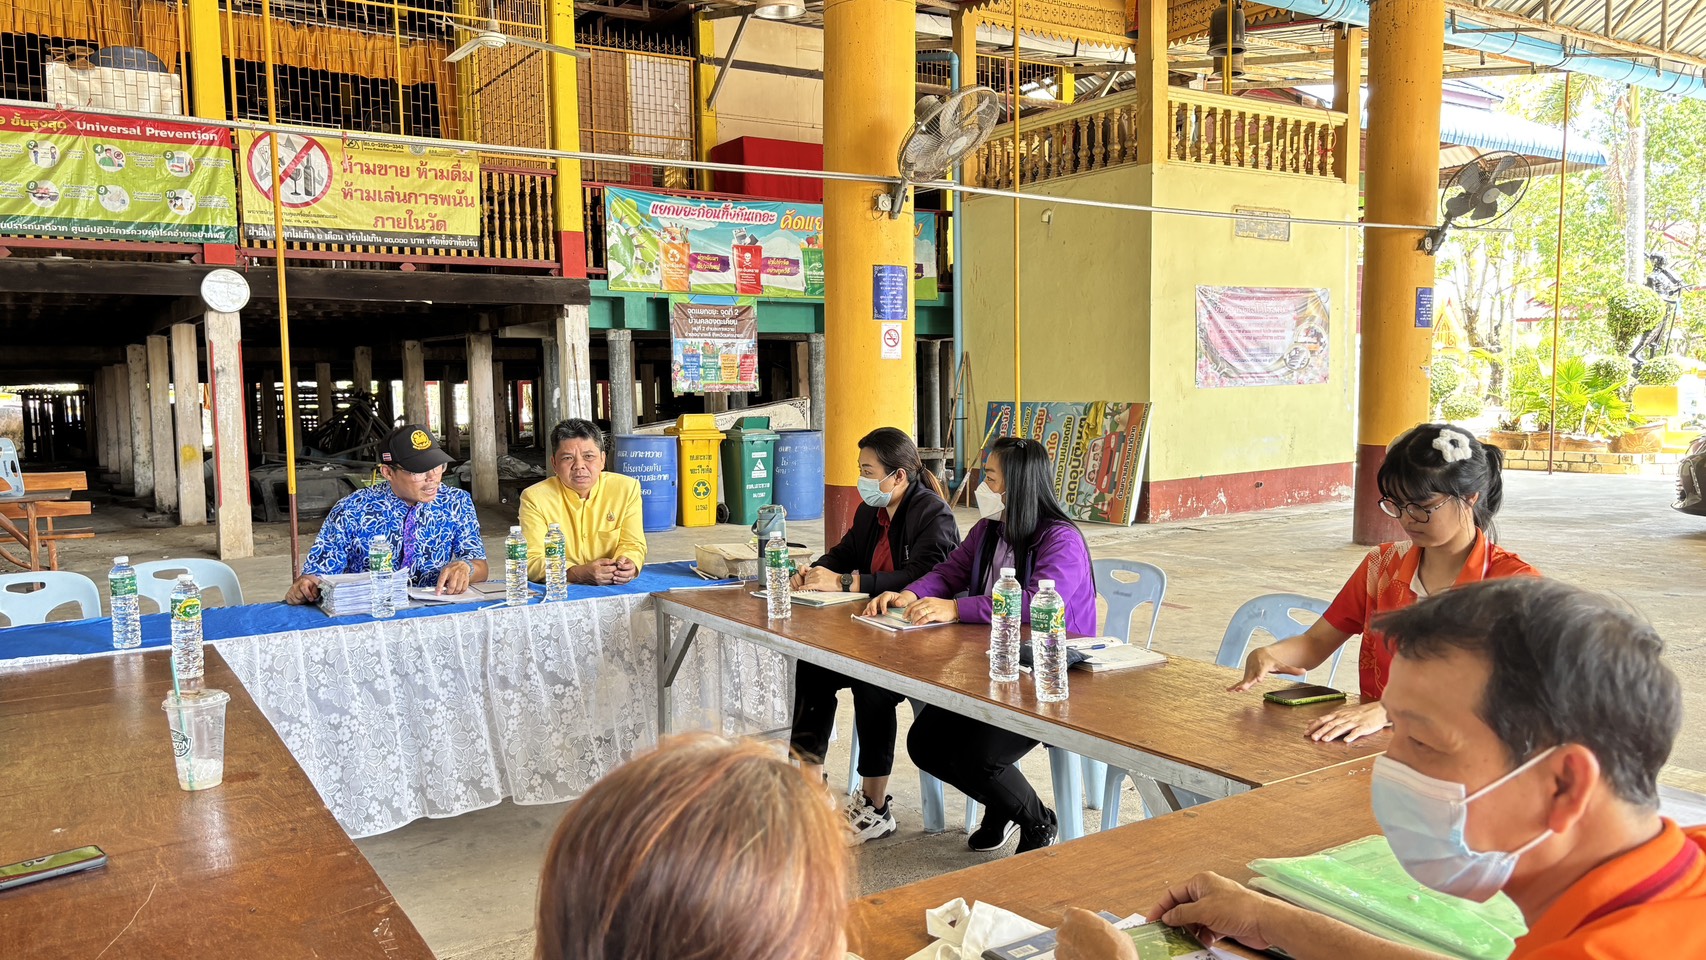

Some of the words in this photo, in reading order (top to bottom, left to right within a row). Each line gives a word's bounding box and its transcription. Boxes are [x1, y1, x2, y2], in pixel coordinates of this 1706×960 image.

[11, 112, 67, 132] ขั้นสูงสุด
[76, 121, 141, 136] Universal
[146, 127, 218, 141] Prevention
[341, 155, 410, 178] ห้ามขาย
[416, 159, 474, 182] ห้ามดื่ม
[341, 180, 475, 208] ห้ามเล่นการพนัน
[373, 209, 447, 232] ภายในวัด
[651, 203, 776, 223] แยกขยะก่อนทิ้งกันเถอะ
[248, 226, 270, 237] ฝ่าฝืน
[324, 230, 344, 241] เดือน
[346, 232, 382, 243] ปรับไม่เกิน
[1032, 408, 1046, 440] งวินัย
